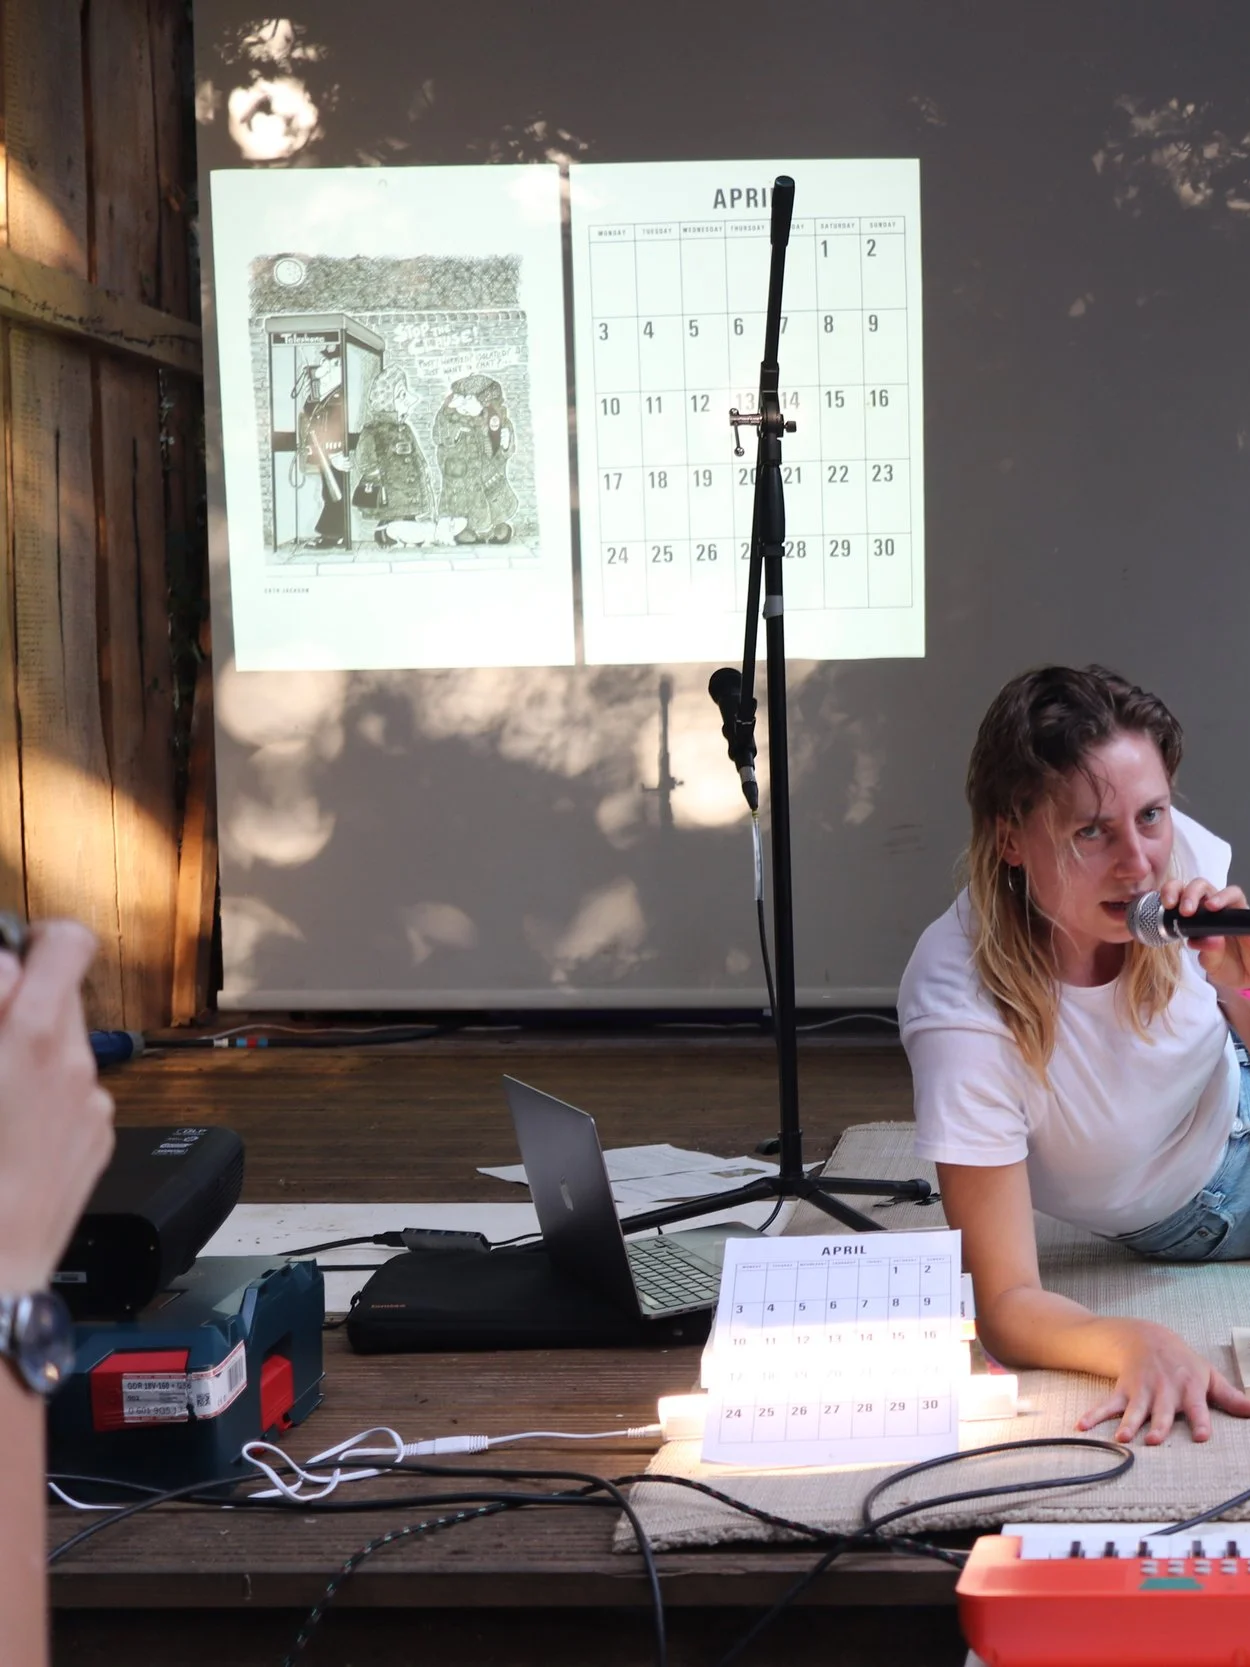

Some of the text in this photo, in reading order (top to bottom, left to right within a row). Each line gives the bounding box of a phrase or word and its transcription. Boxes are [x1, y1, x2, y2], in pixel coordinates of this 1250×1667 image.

[713, 187, 773, 209] APRI
[869, 221, 897, 229] SUNDAY
[821, 239, 877, 258] 1 2
[599, 315, 878, 340] 3 4 5 6 7 8 9
[601, 389, 889, 416] 10 11 12 13 14 15 16
[604, 473, 623, 490] 17
[648, 471, 667, 489] 18
[693, 470, 713, 487] 19
[783, 466, 801, 484] 21
[828, 465, 849, 483] 22
[872, 464, 893, 482] 23
[607, 547, 628, 564] 24
[652, 546, 673, 563] 25
[696, 544, 717, 562] 26
[785, 540, 807, 558] 28
[829, 540, 851, 557] 29
[874, 539, 895, 557] 30
[821, 1245, 867, 1256] APRIL
[736, 1298, 931, 1314] 3 4 5 6 7 8 9
[733, 1331, 936, 1346] 10 11 12 13 14 15 16
[725, 1400, 938, 1418] 24 25 26 27 28 29 30
